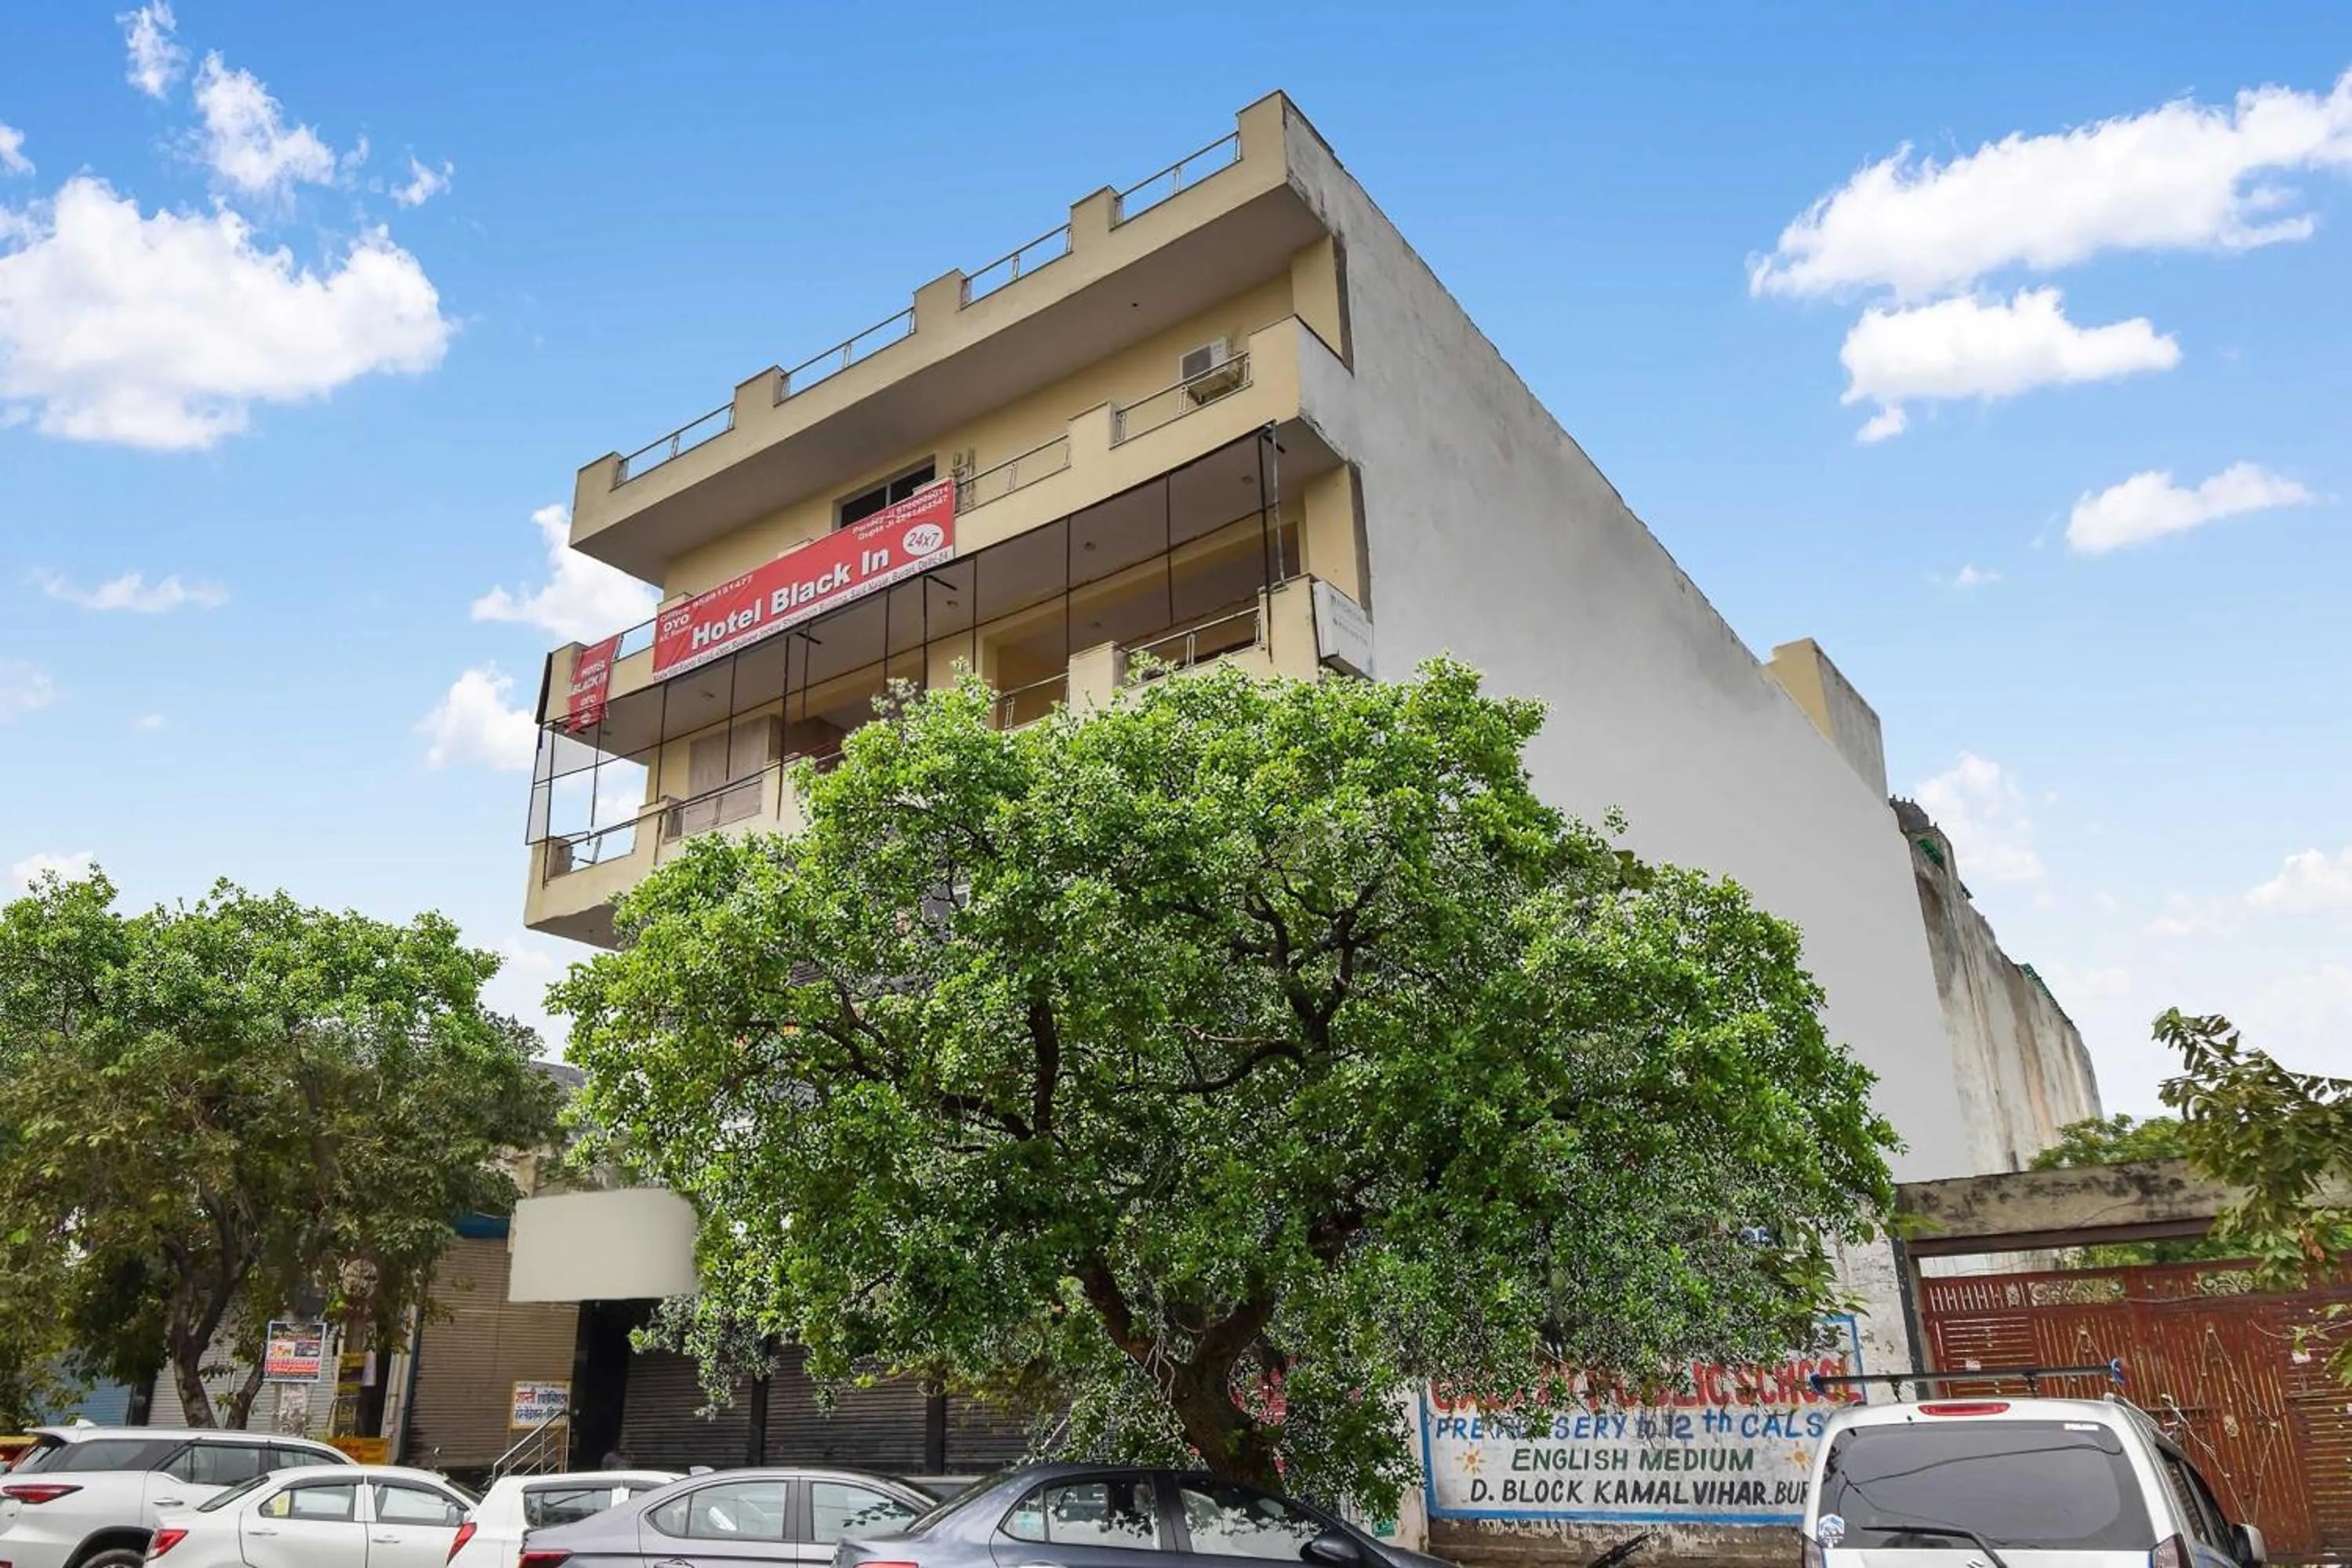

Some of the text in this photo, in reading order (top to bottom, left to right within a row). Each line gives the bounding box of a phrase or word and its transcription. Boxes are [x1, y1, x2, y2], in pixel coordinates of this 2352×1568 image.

[907, 532, 940, 548] 24x7
[691, 597, 764, 651] Hotel
[771, 561, 853, 615] Black
[861, 548, 891, 578] In
[663, 613, 690, 633] OYO
[1436, 1417, 1483, 1440] PRE
[1702, 1408, 1733, 1434] th
[1511, 1448, 1754, 1472] ENGLISH MEDIUM
[1469, 1479, 1494, 1504] D.
[1501, 1479, 1584, 1504] BLOCK
[1593, 1479, 1690, 1504] KAMAL
